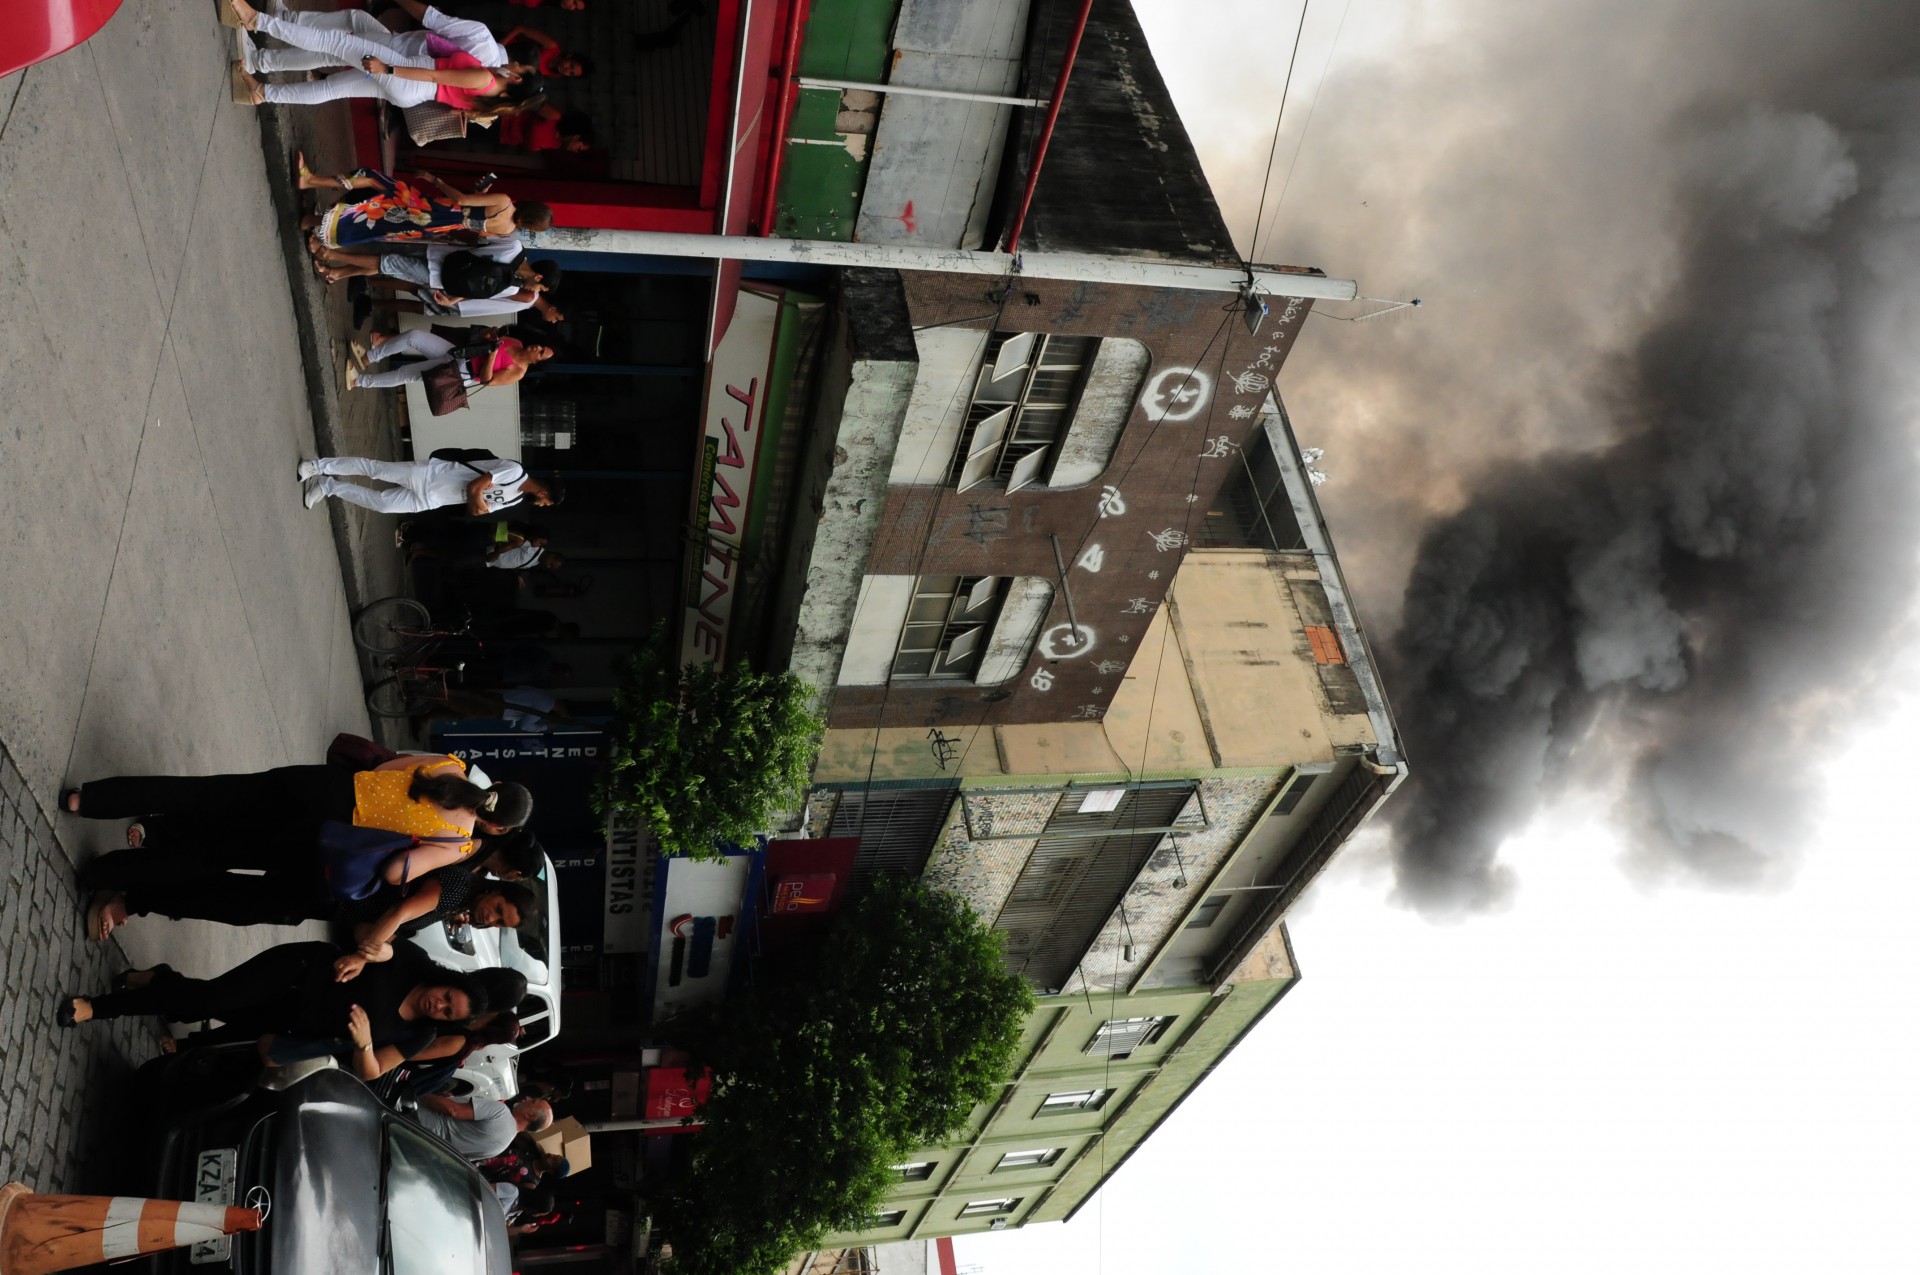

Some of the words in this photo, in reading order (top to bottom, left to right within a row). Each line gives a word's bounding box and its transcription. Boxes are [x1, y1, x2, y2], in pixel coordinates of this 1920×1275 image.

[693, 377, 758, 680] TAMINE
[452, 746, 598, 760] DENTISTAS
[609, 812, 638, 914] ENTISTAS
